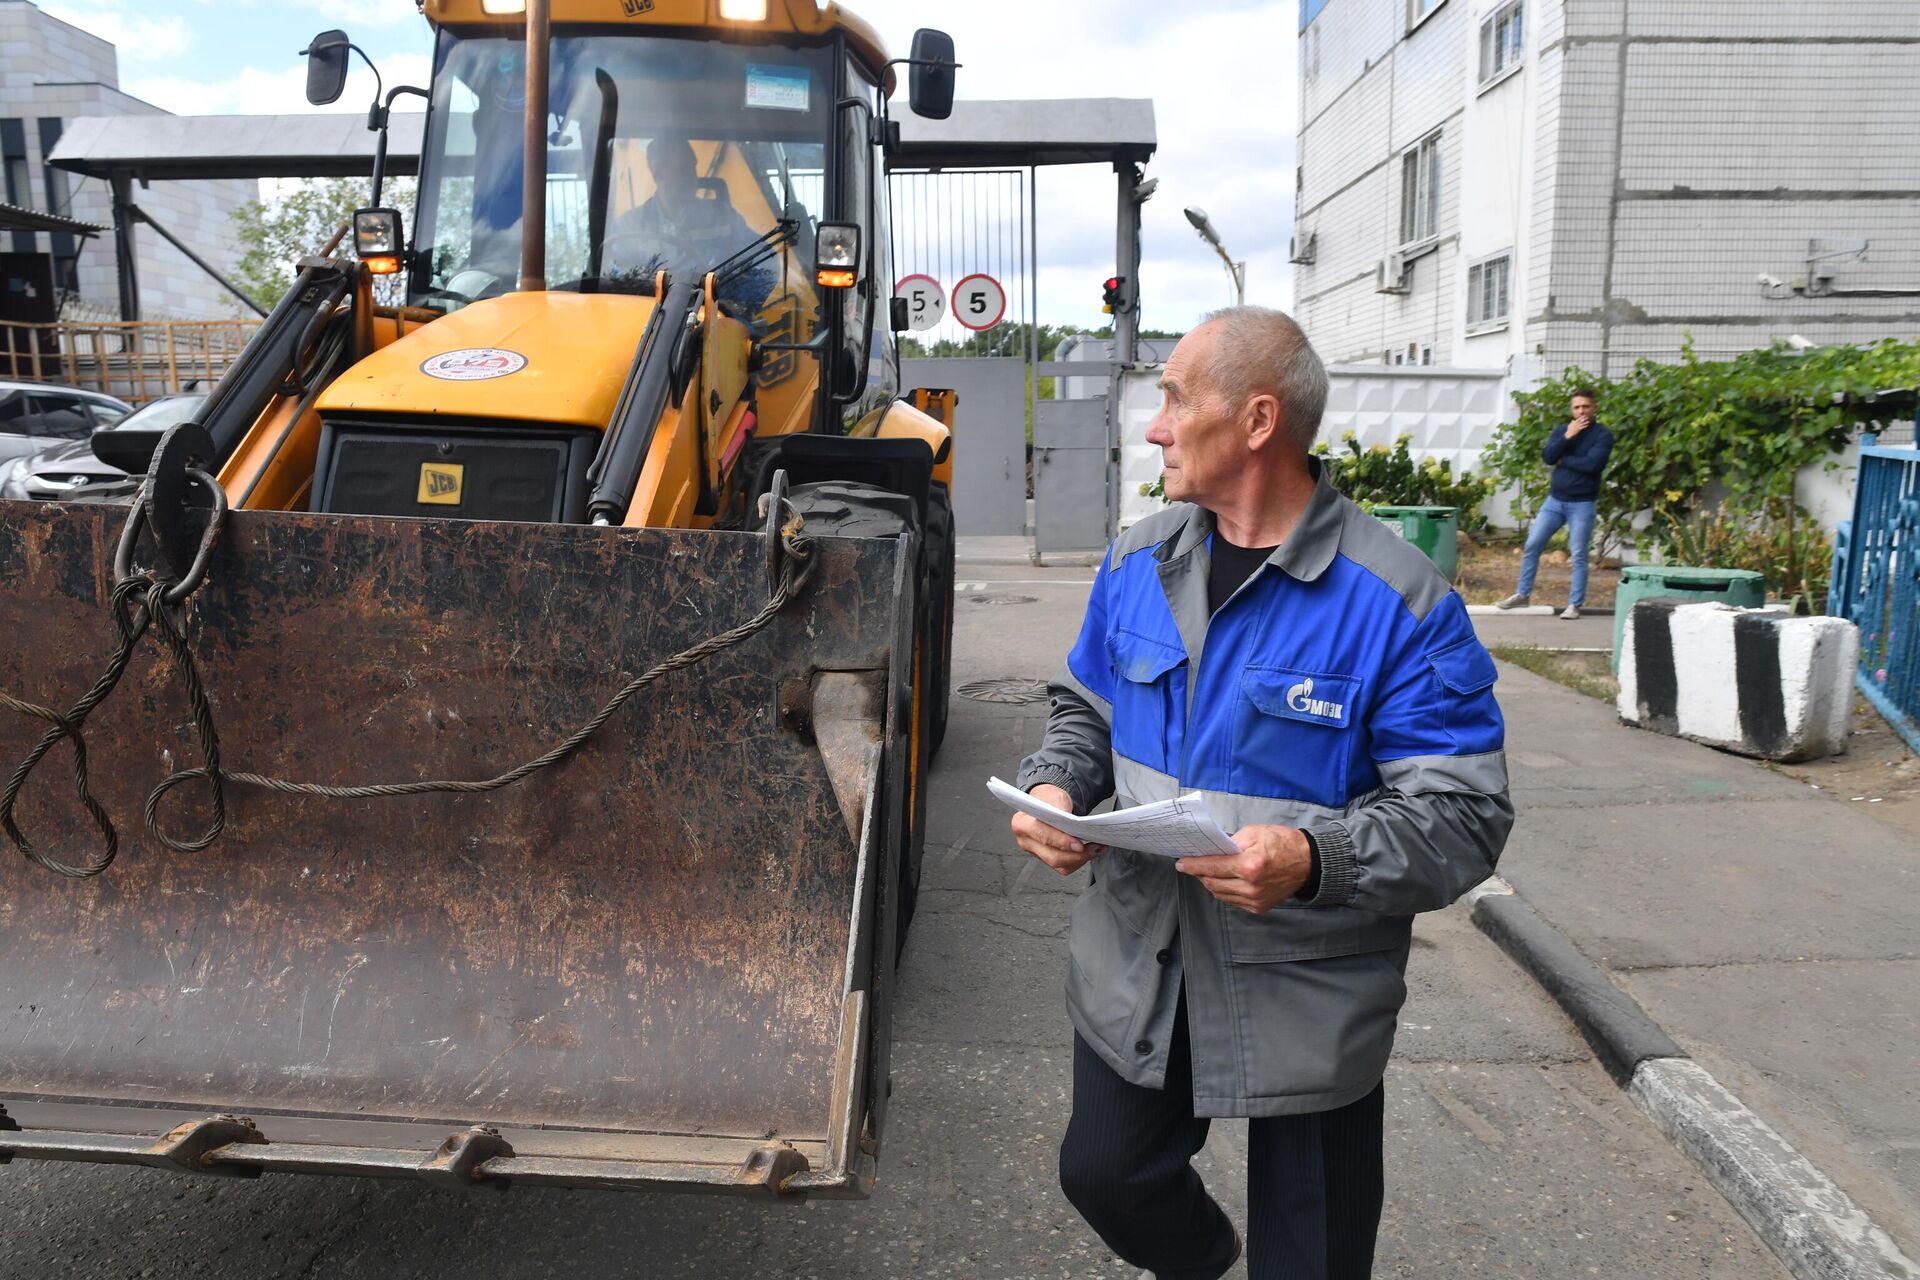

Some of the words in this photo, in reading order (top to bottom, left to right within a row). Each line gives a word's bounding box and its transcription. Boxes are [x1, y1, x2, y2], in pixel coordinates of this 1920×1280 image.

[912, 290, 925, 311] 5
[969, 291, 987, 314] 5
[429, 473, 455, 494] JCB
